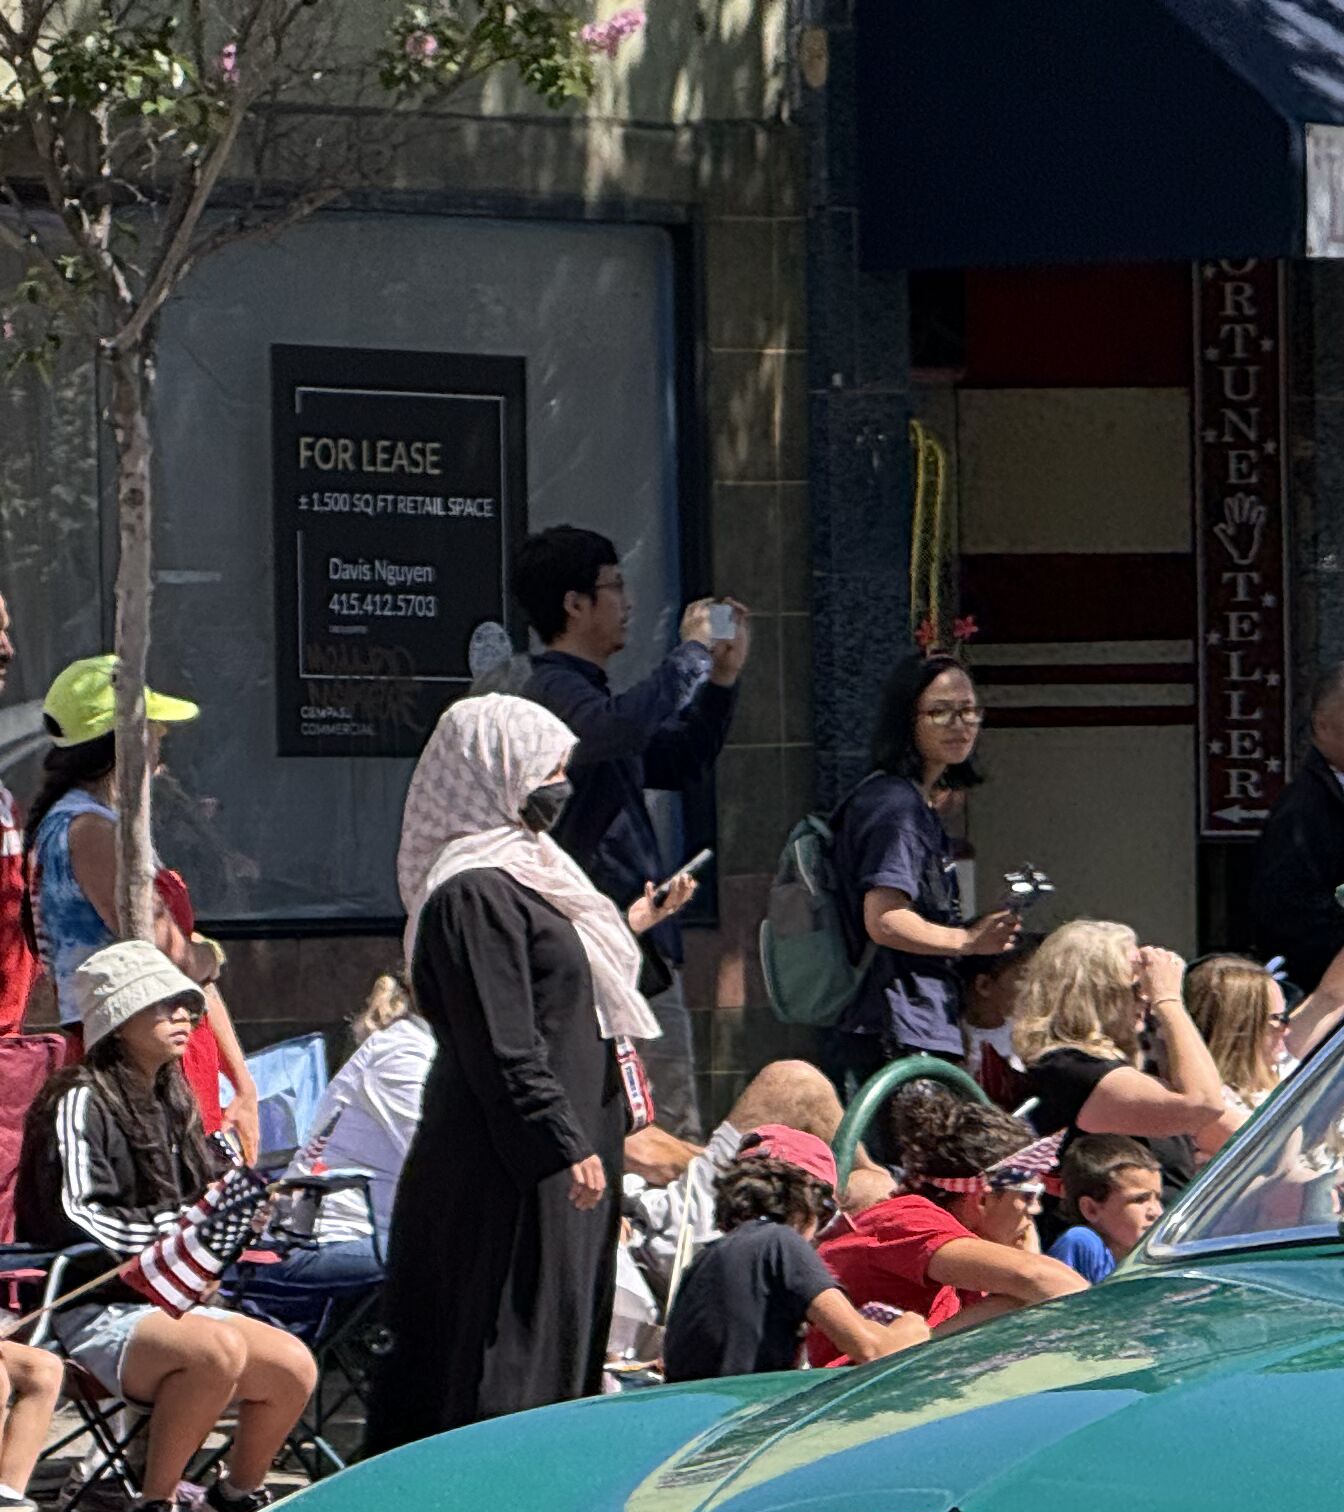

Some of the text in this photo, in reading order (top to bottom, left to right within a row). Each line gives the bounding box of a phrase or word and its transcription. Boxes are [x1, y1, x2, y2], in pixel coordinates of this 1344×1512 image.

[300, 436, 443, 475] FOR LEASE
[352, 493, 375, 516] SQ
[376, 494, 395, 513] FT
[399, 495, 446, 516] RETAIL
[448, 497, 496, 518] SPACE
[328, 557, 433, 586] Davis Nguyen
[328, 593, 437, 618] 415.412.5703
[1221, 571, 1264, 799] TELLER
